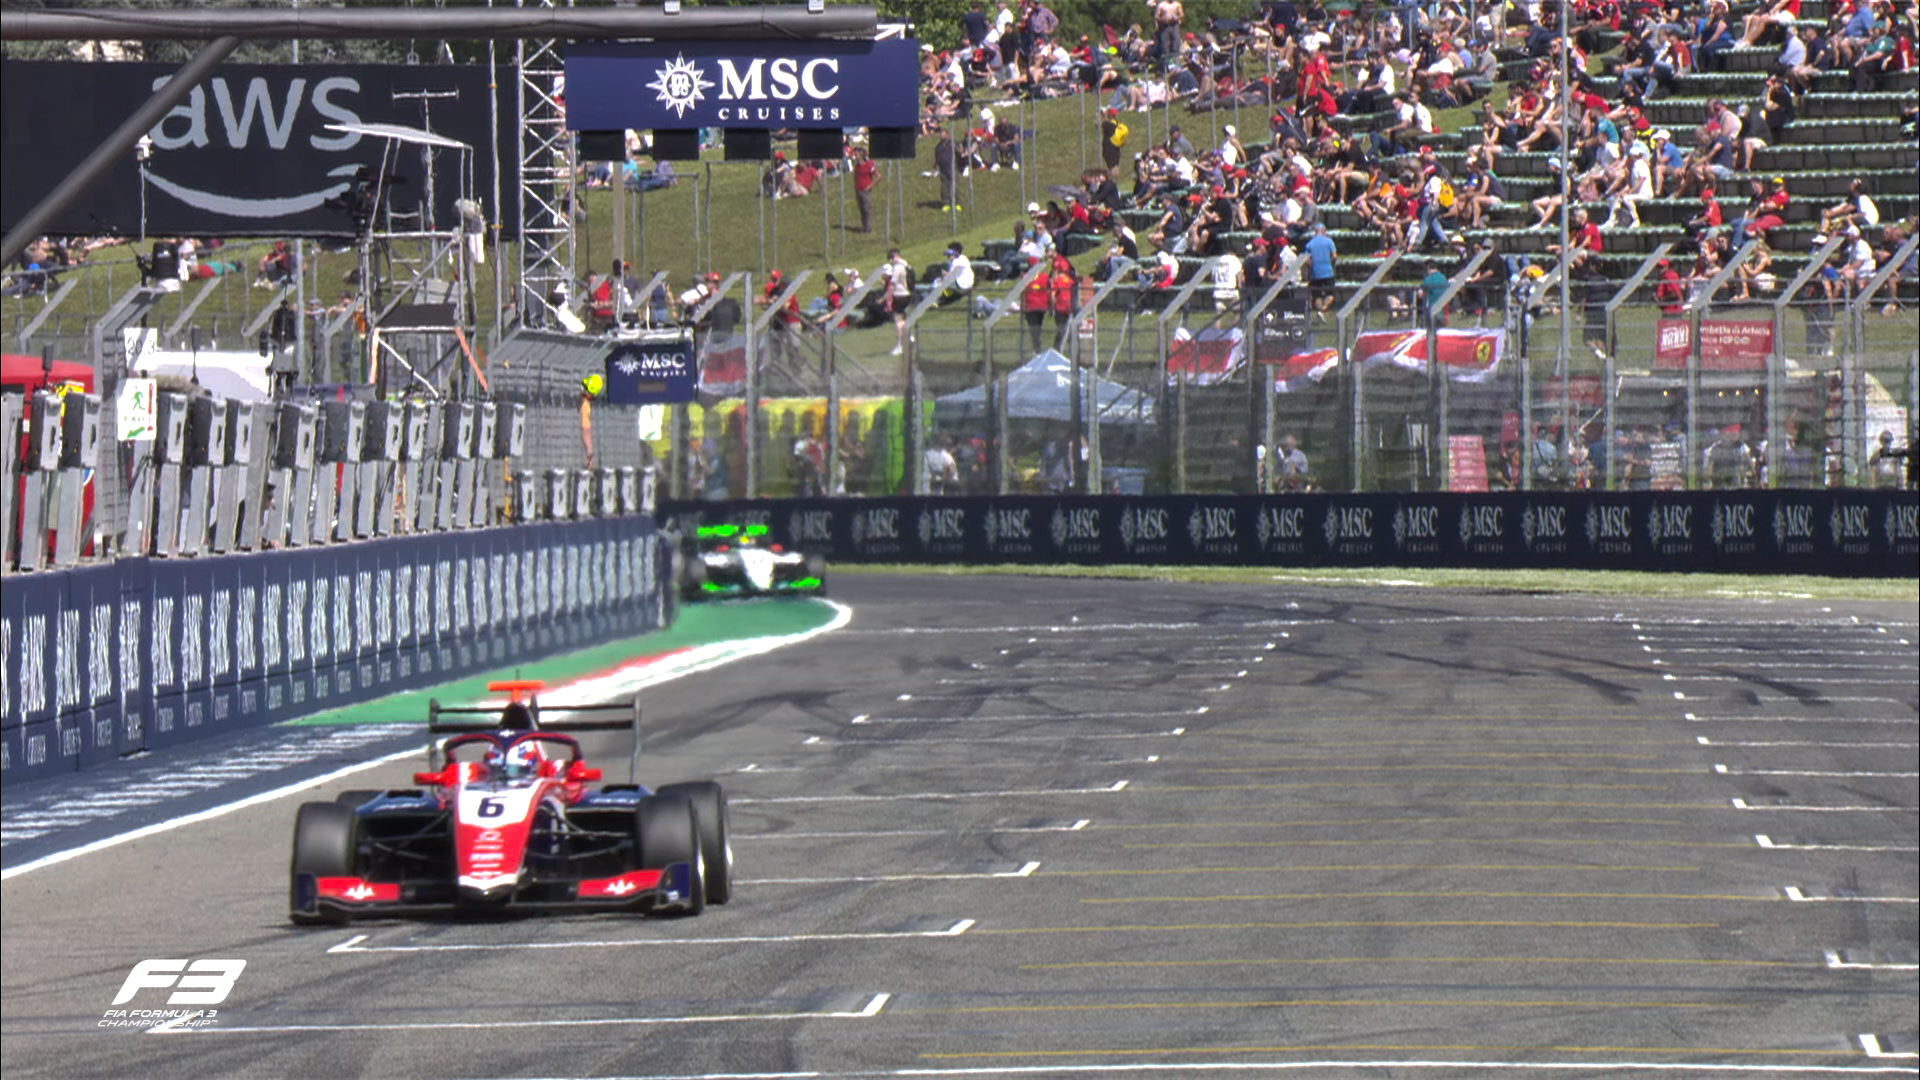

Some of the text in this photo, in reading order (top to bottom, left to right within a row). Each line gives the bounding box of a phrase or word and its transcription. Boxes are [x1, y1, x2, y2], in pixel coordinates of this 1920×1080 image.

[717, 58, 839, 100] MSC
[148, 74, 362, 151] aws
[718, 107, 840, 120] CRUISES
[641, 353, 686, 369] MSC
[477, 796, 508, 818] 6
